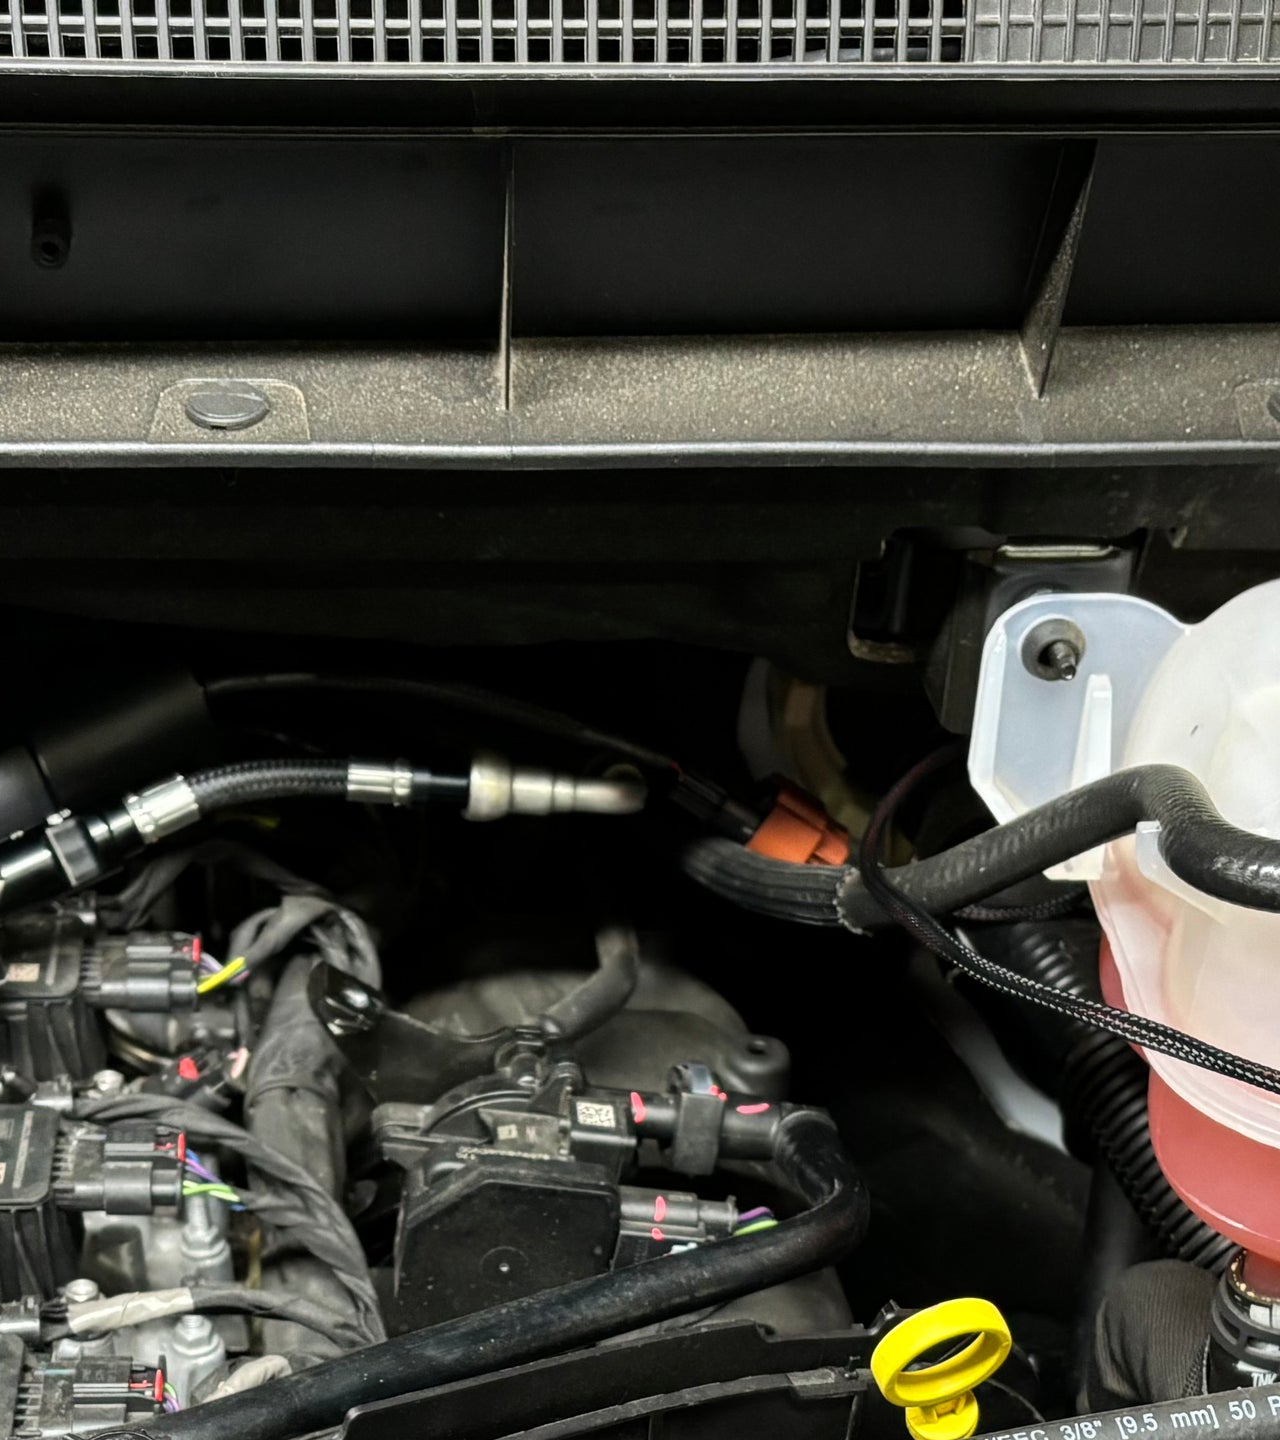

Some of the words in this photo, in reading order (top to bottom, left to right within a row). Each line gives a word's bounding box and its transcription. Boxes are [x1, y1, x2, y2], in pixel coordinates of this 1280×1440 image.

[1118, 1412, 1158, 1440] [9.5
[1171, 1404, 1220, 1430] mm]
[1229, 1399, 1257, 1421] 50
